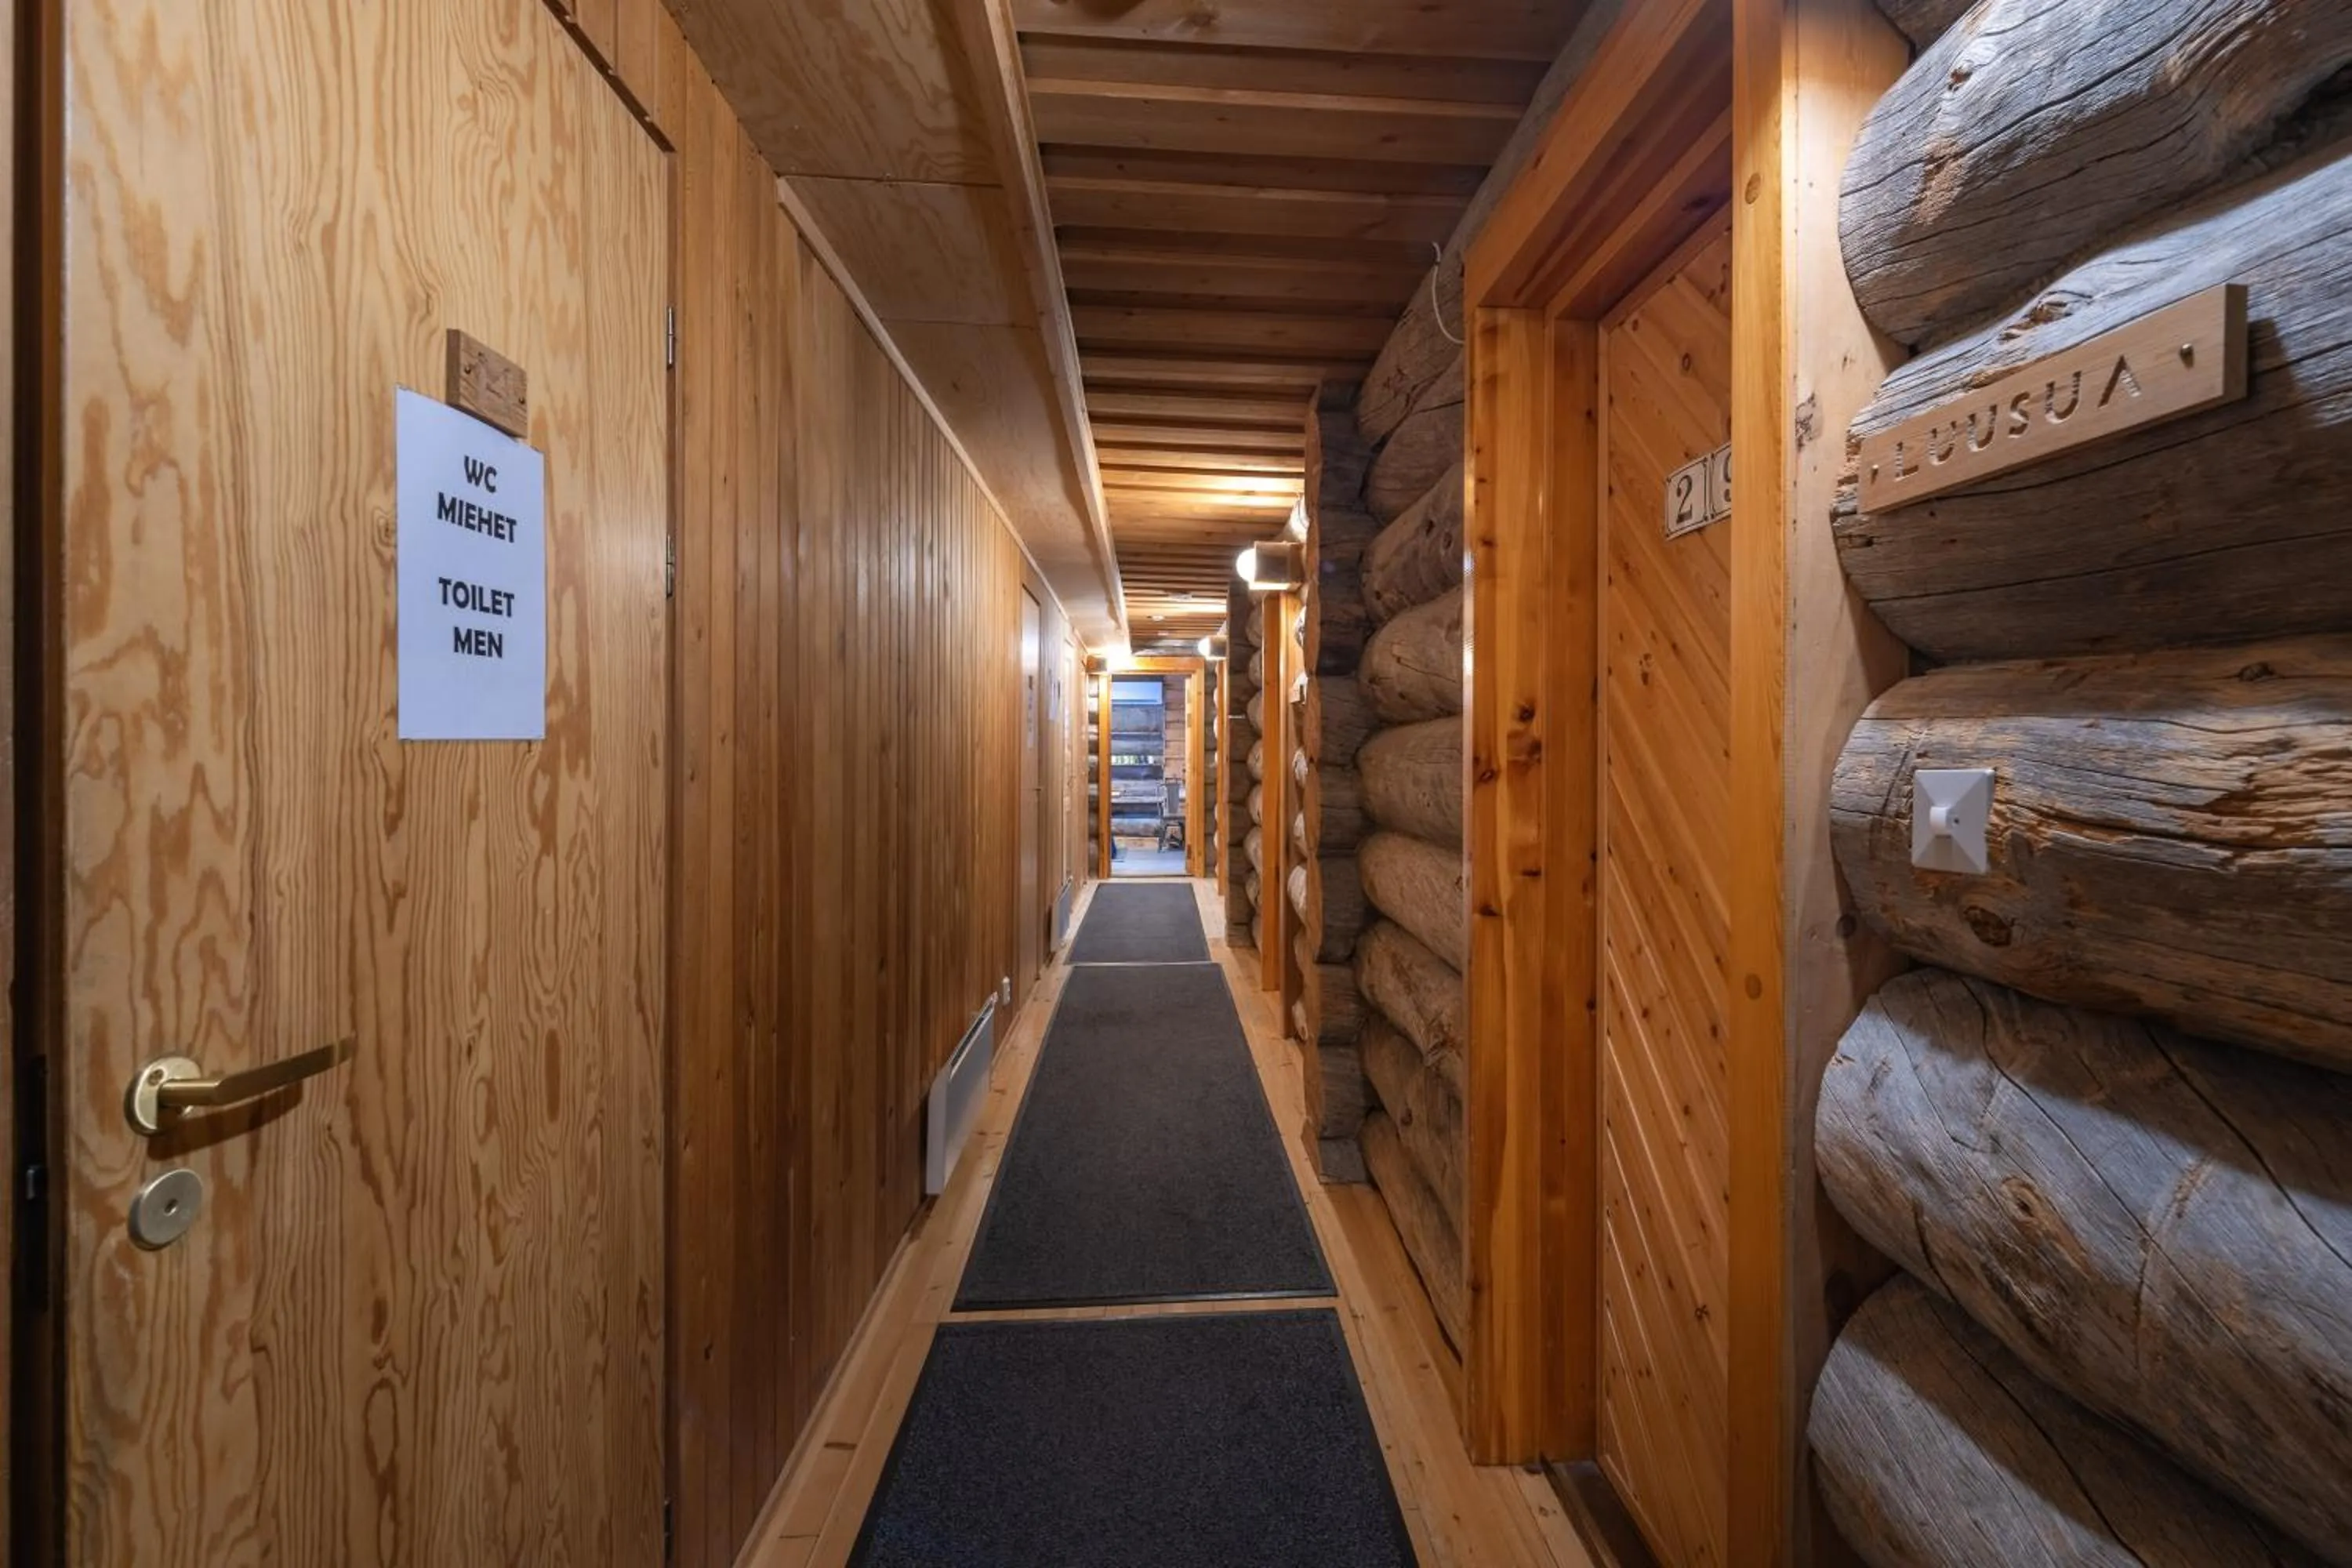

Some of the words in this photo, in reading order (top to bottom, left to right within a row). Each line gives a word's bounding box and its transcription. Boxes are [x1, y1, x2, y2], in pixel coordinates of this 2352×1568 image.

[1894, 354, 2142, 481] LUUSUA
[463, 455, 497, 494] WC
[437, 491, 517, 543] MIEHET
[438, 576, 515, 618] TOILET
[454, 626, 503, 659] MEN
